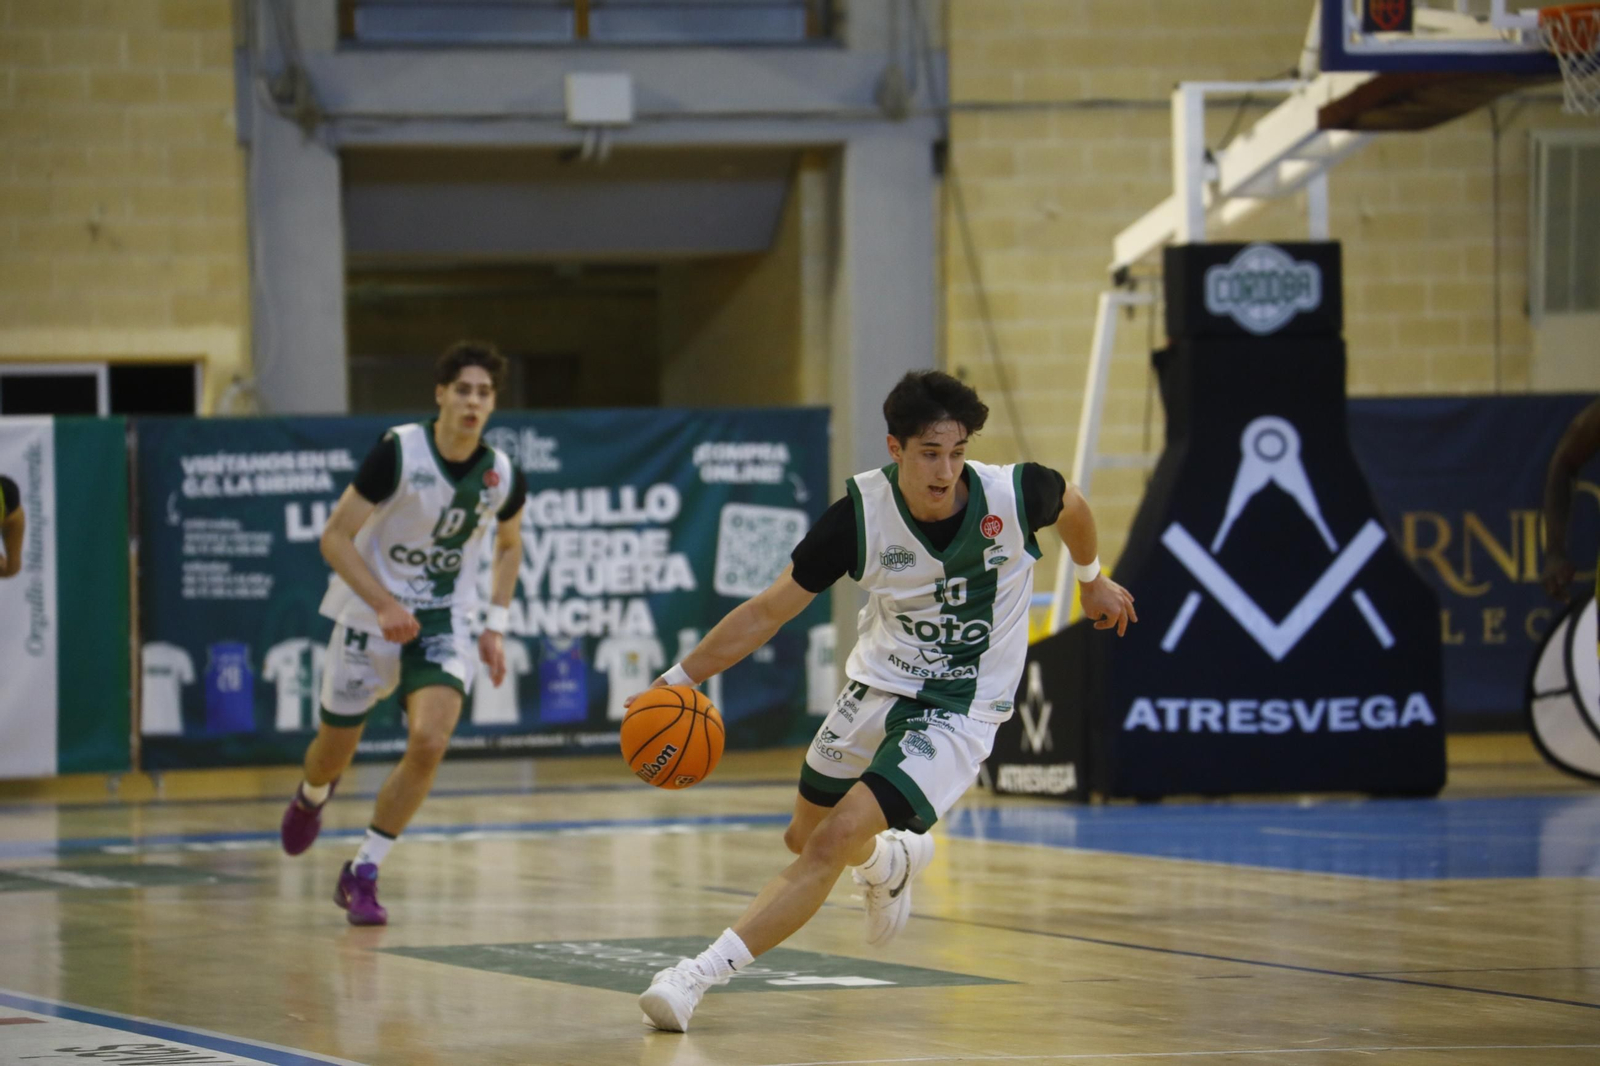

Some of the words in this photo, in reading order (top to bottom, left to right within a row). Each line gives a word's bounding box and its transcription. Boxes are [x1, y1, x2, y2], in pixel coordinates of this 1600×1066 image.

[389, 544, 461, 571] coto
[934, 577, 968, 606] 10
[896, 614, 991, 643] coto
[1123, 694, 1437, 734] ATRESVEGA
